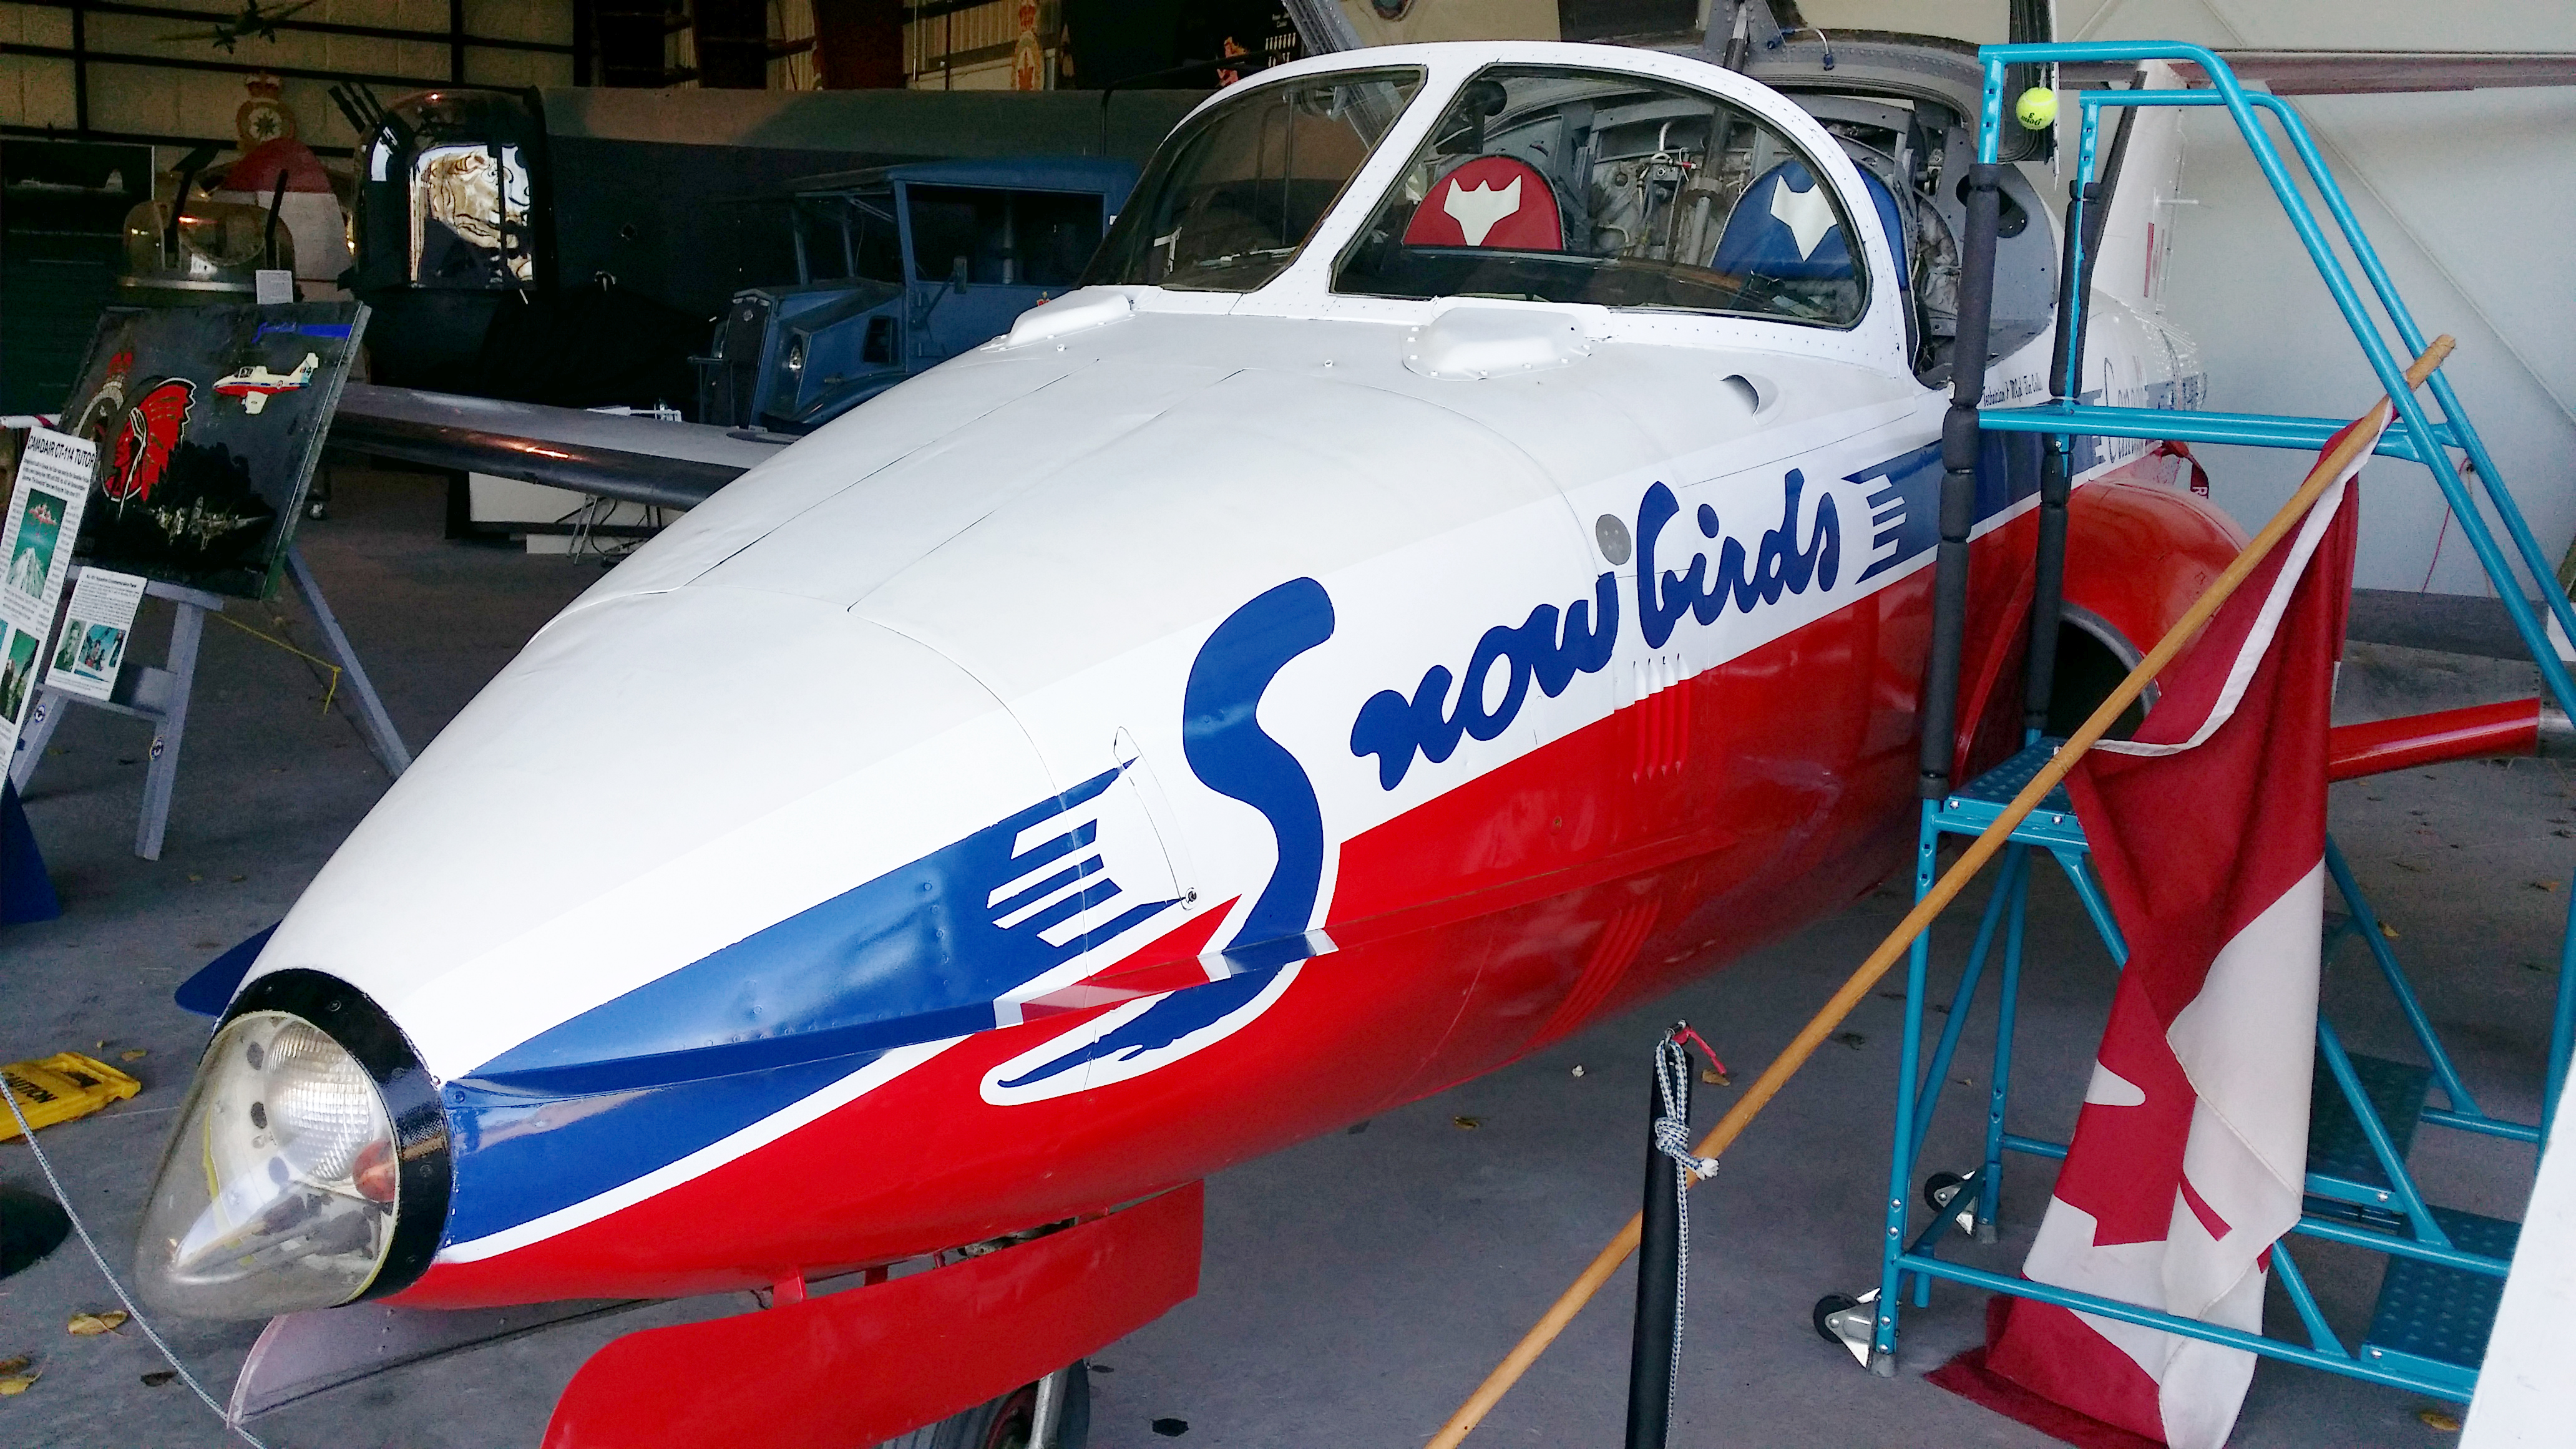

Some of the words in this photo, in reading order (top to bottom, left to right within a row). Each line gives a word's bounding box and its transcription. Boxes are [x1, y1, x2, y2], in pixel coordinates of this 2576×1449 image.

[27, 436, 55, 457] CANADAIR
[55, 443, 74, 462] CT-114
[74, 447, 95, 468] TUTOR
[997, 468, 1841, 1088] Snowbirds
